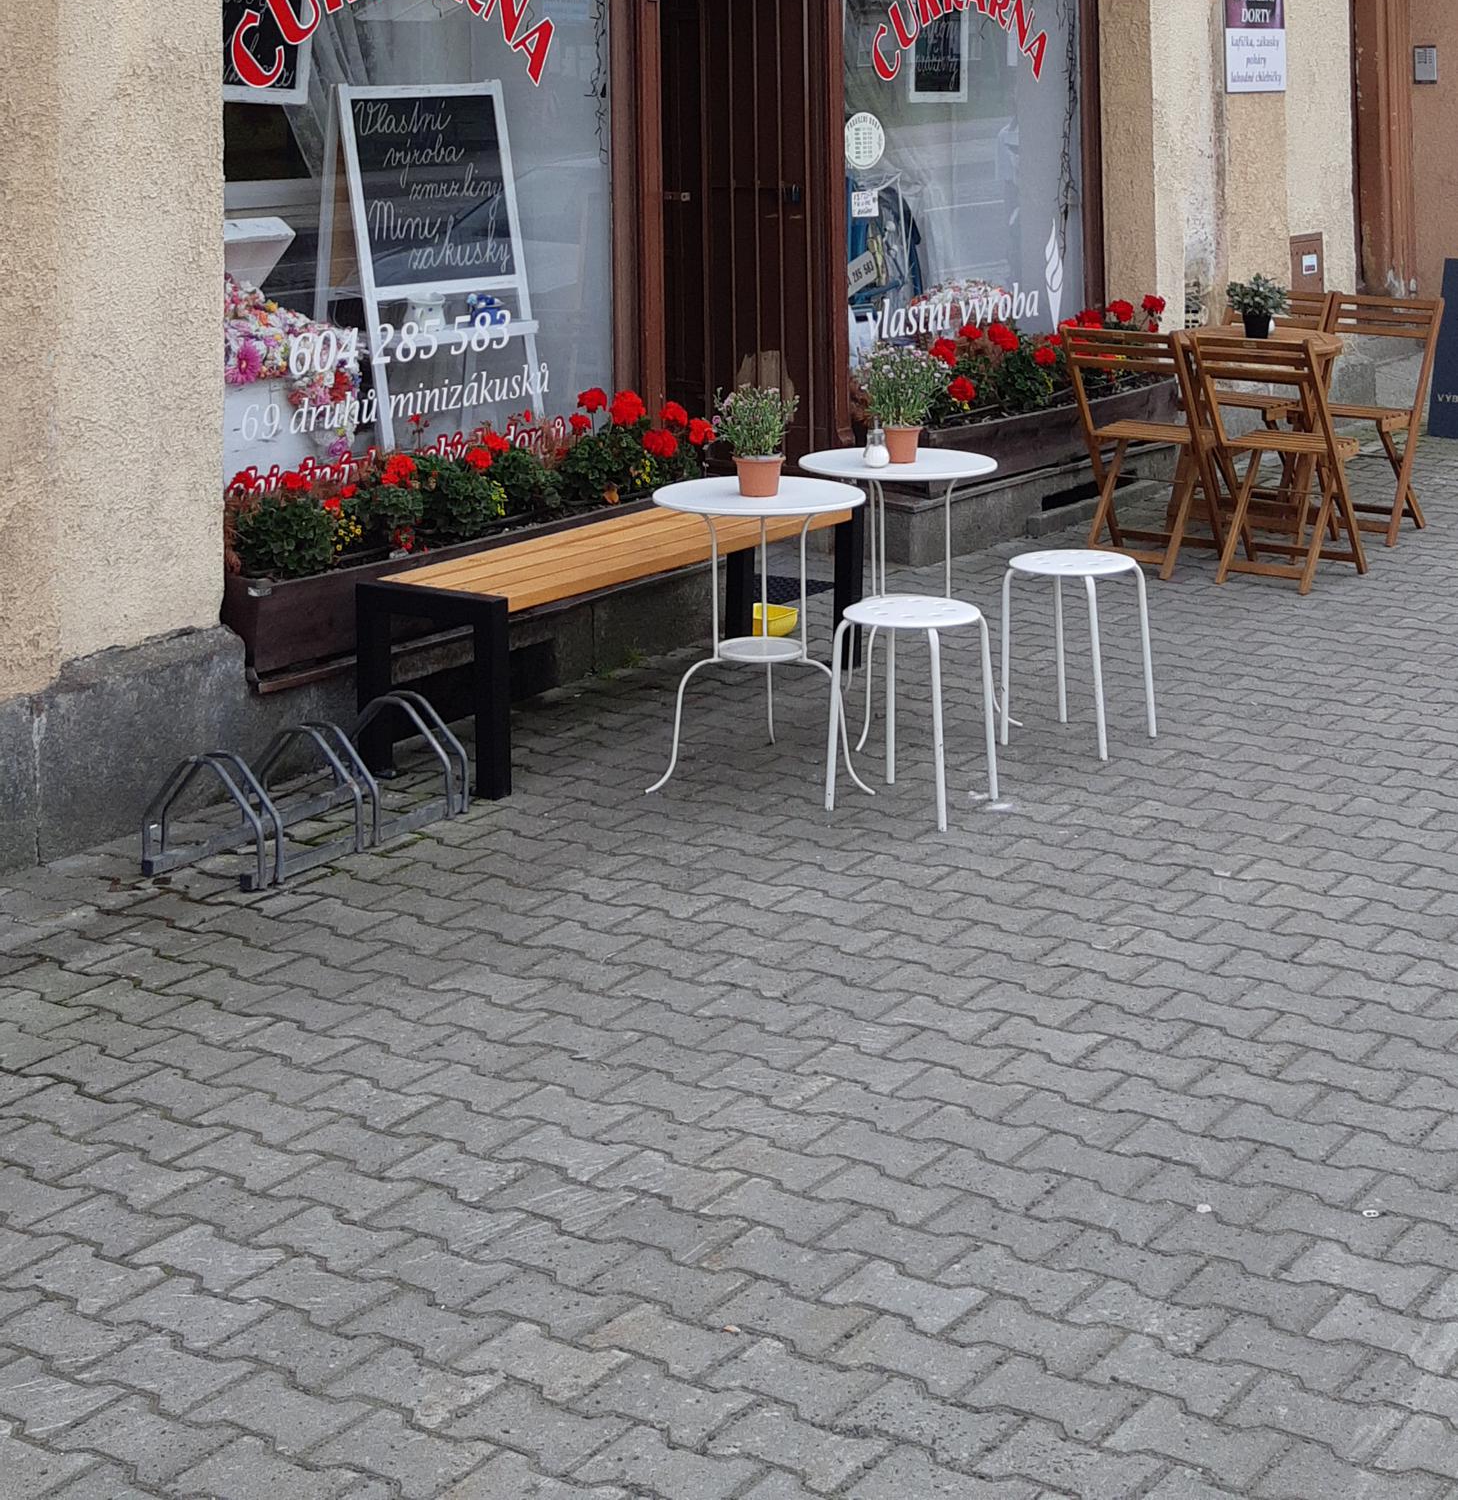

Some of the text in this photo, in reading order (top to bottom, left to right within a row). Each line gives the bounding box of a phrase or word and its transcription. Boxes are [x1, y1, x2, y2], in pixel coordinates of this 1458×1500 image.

[1241, 8, 1271, 23] DORTY
[354, 100, 452, 136] Vlastní
[383, 133, 465, 189] výroba
[409, 162, 502, 220] zmrzliny
[866, 282, 1039, 339] vlastní výroba
[289, 309, 512, 376] 604 285 583
[241, 363, 550, 441] 69 druhů minizákusků
